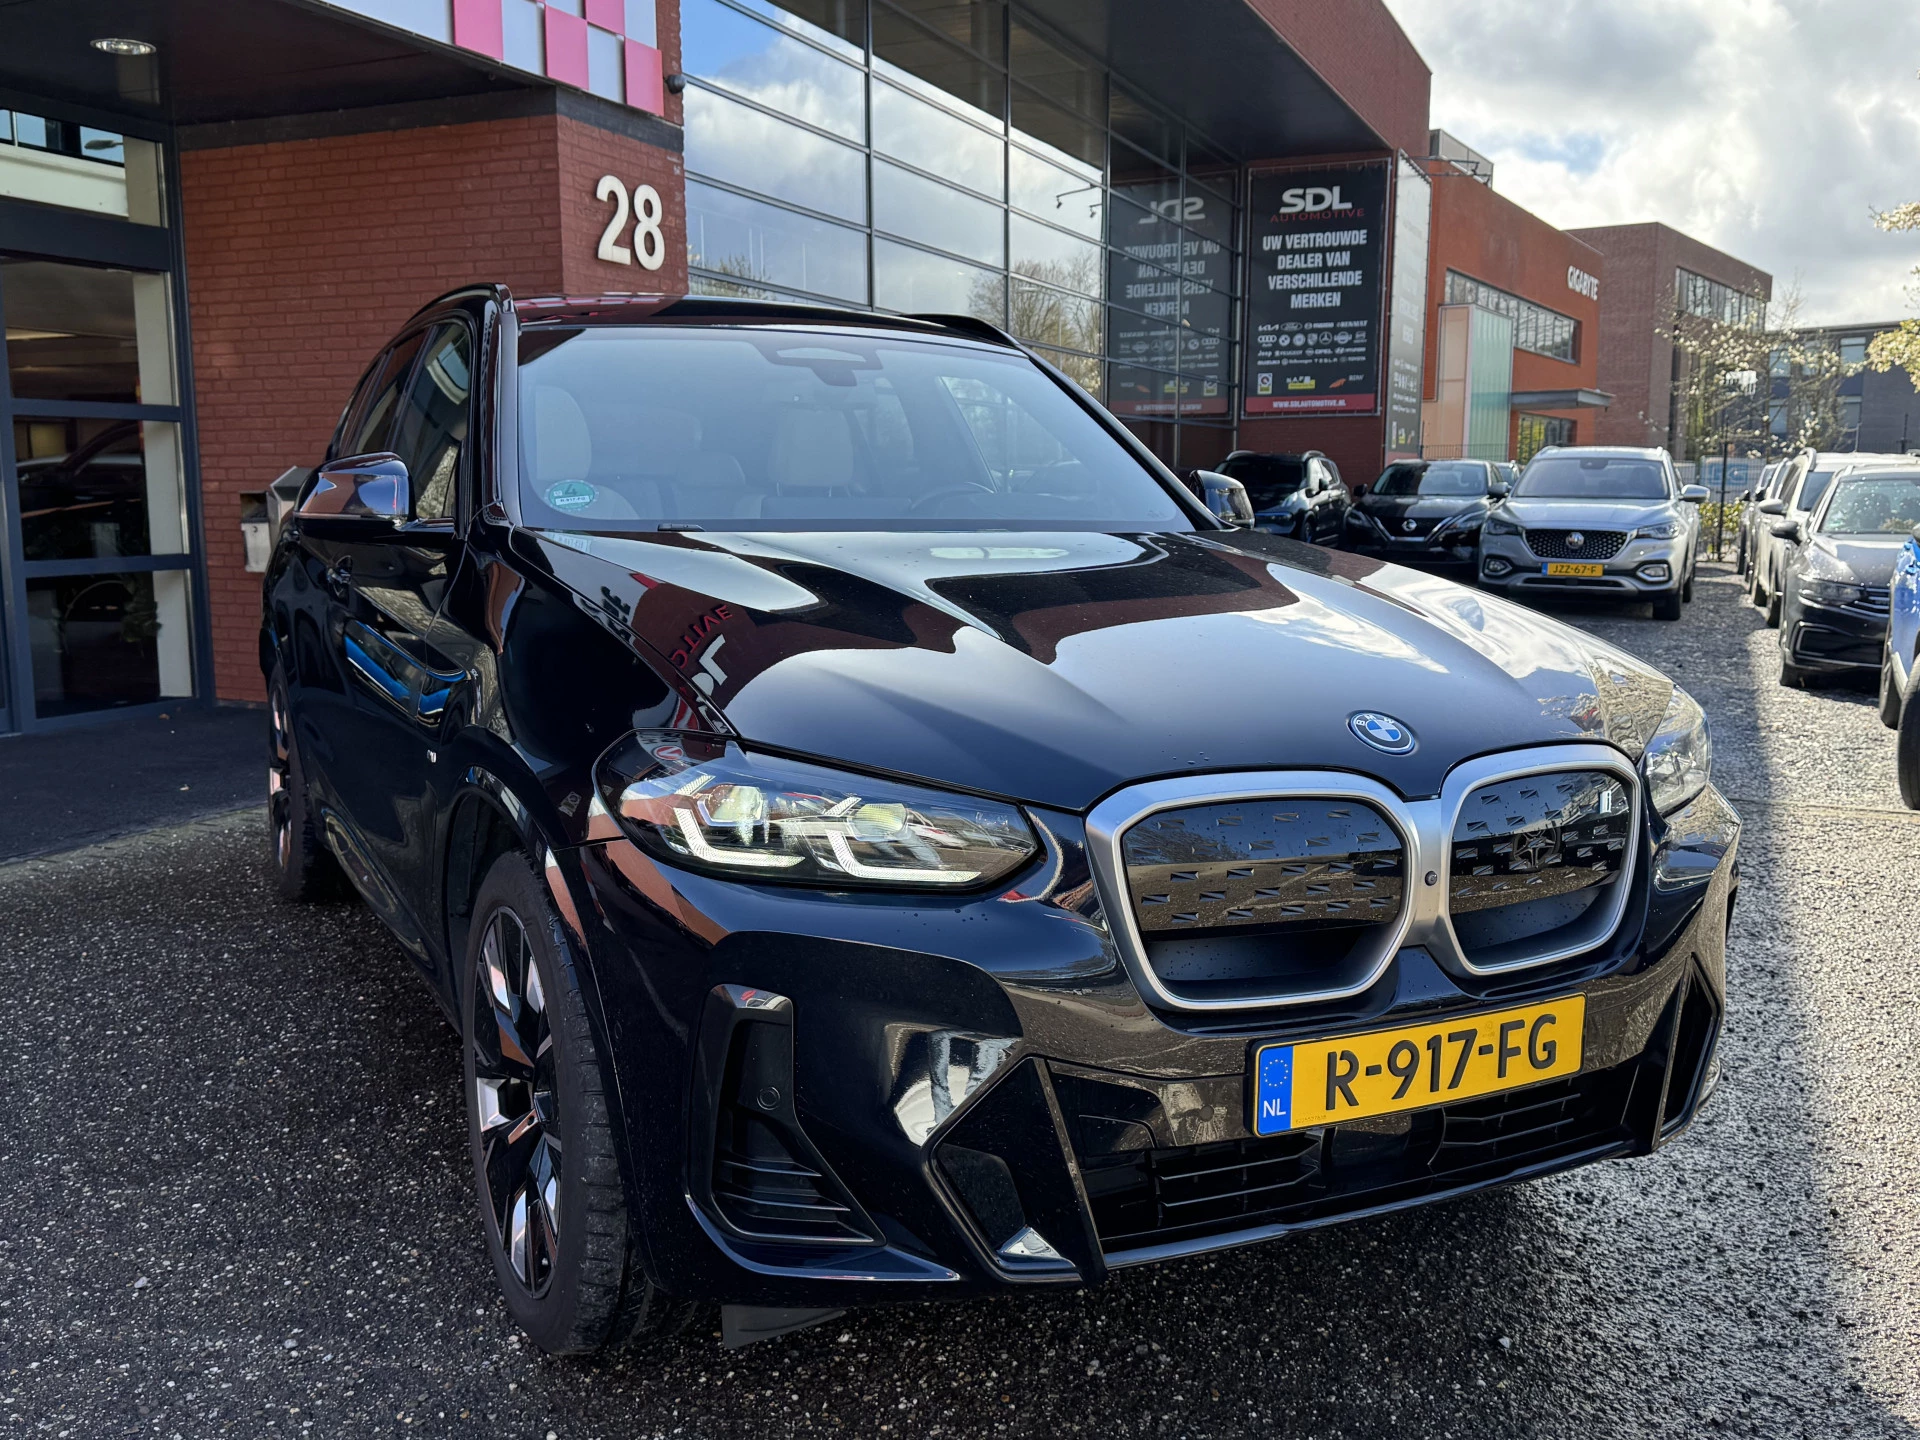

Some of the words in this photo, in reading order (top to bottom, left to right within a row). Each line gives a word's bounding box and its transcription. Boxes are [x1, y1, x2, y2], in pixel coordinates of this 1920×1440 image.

[1279, 185, 1353, 214] SDL
[596, 174, 665, 271] 28
[1270, 208, 1365, 223] AUTOMOTIVE
[1262, 235, 1283, 251] UW
[1285, 229, 1368, 249] VERTROUWDE
[1277, 252, 1323, 270] DEALER
[1325, 250, 1351, 267] VAN
[1268, 270, 1363, 290] VERSCHILLENDE
[1290, 291, 1342, 309] MERKEN
[1553, 564, 1597, 574] JZZ-67-F
[1356, 713, 1395, 727] BMW
[1325, 1013, 1557, 1111] R-917-FG
[1262, 1098, 1287, 1118] NL
